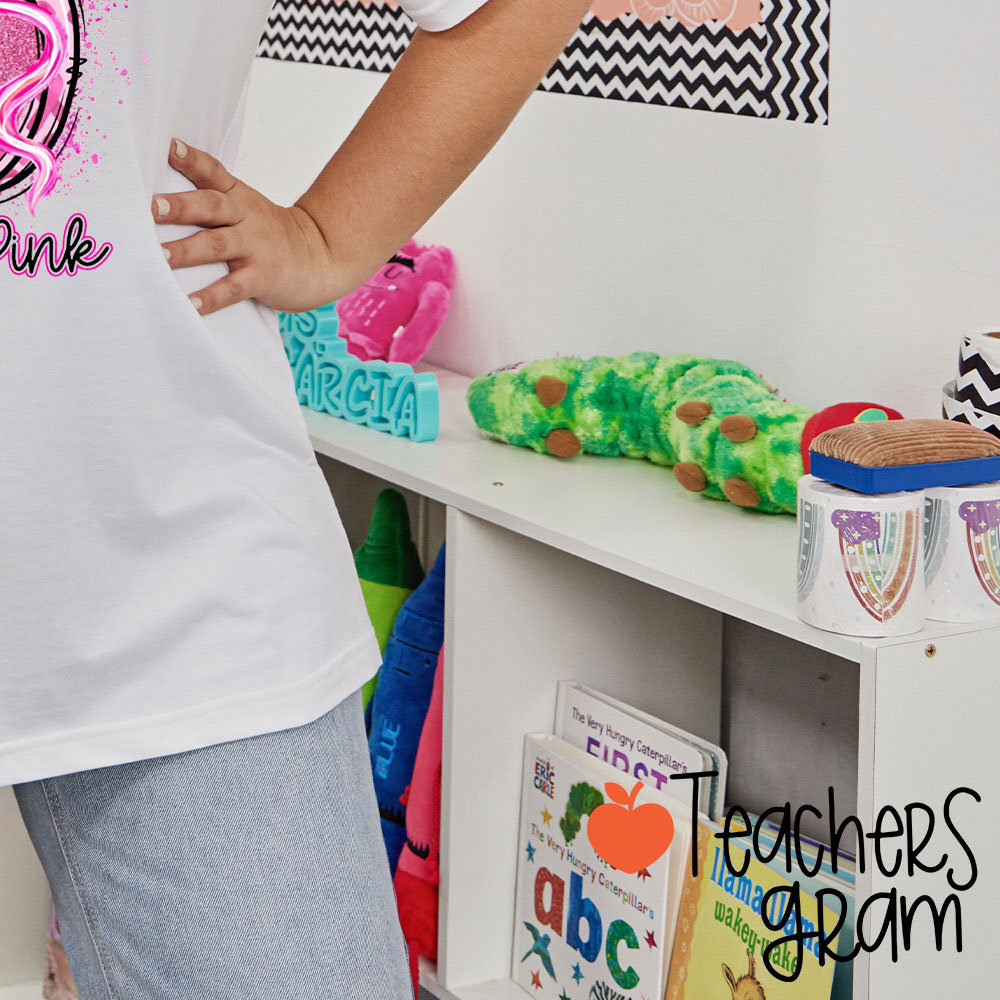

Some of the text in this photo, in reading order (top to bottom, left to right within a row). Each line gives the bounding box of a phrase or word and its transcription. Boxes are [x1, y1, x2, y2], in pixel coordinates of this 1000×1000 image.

[286, 352, 418, 437] ARCIA
[375, 719, 401, 779] BLUE
[534, 762, 556, 786] ERIC
[572, 706, 688, 775] The Very Hungry Caterpillar's
[534, 776, 556, 800] CARLE
[531, 822, 655, 920] The Very Hungry Caterpillar's
[534, 866, 640, 990] abc
